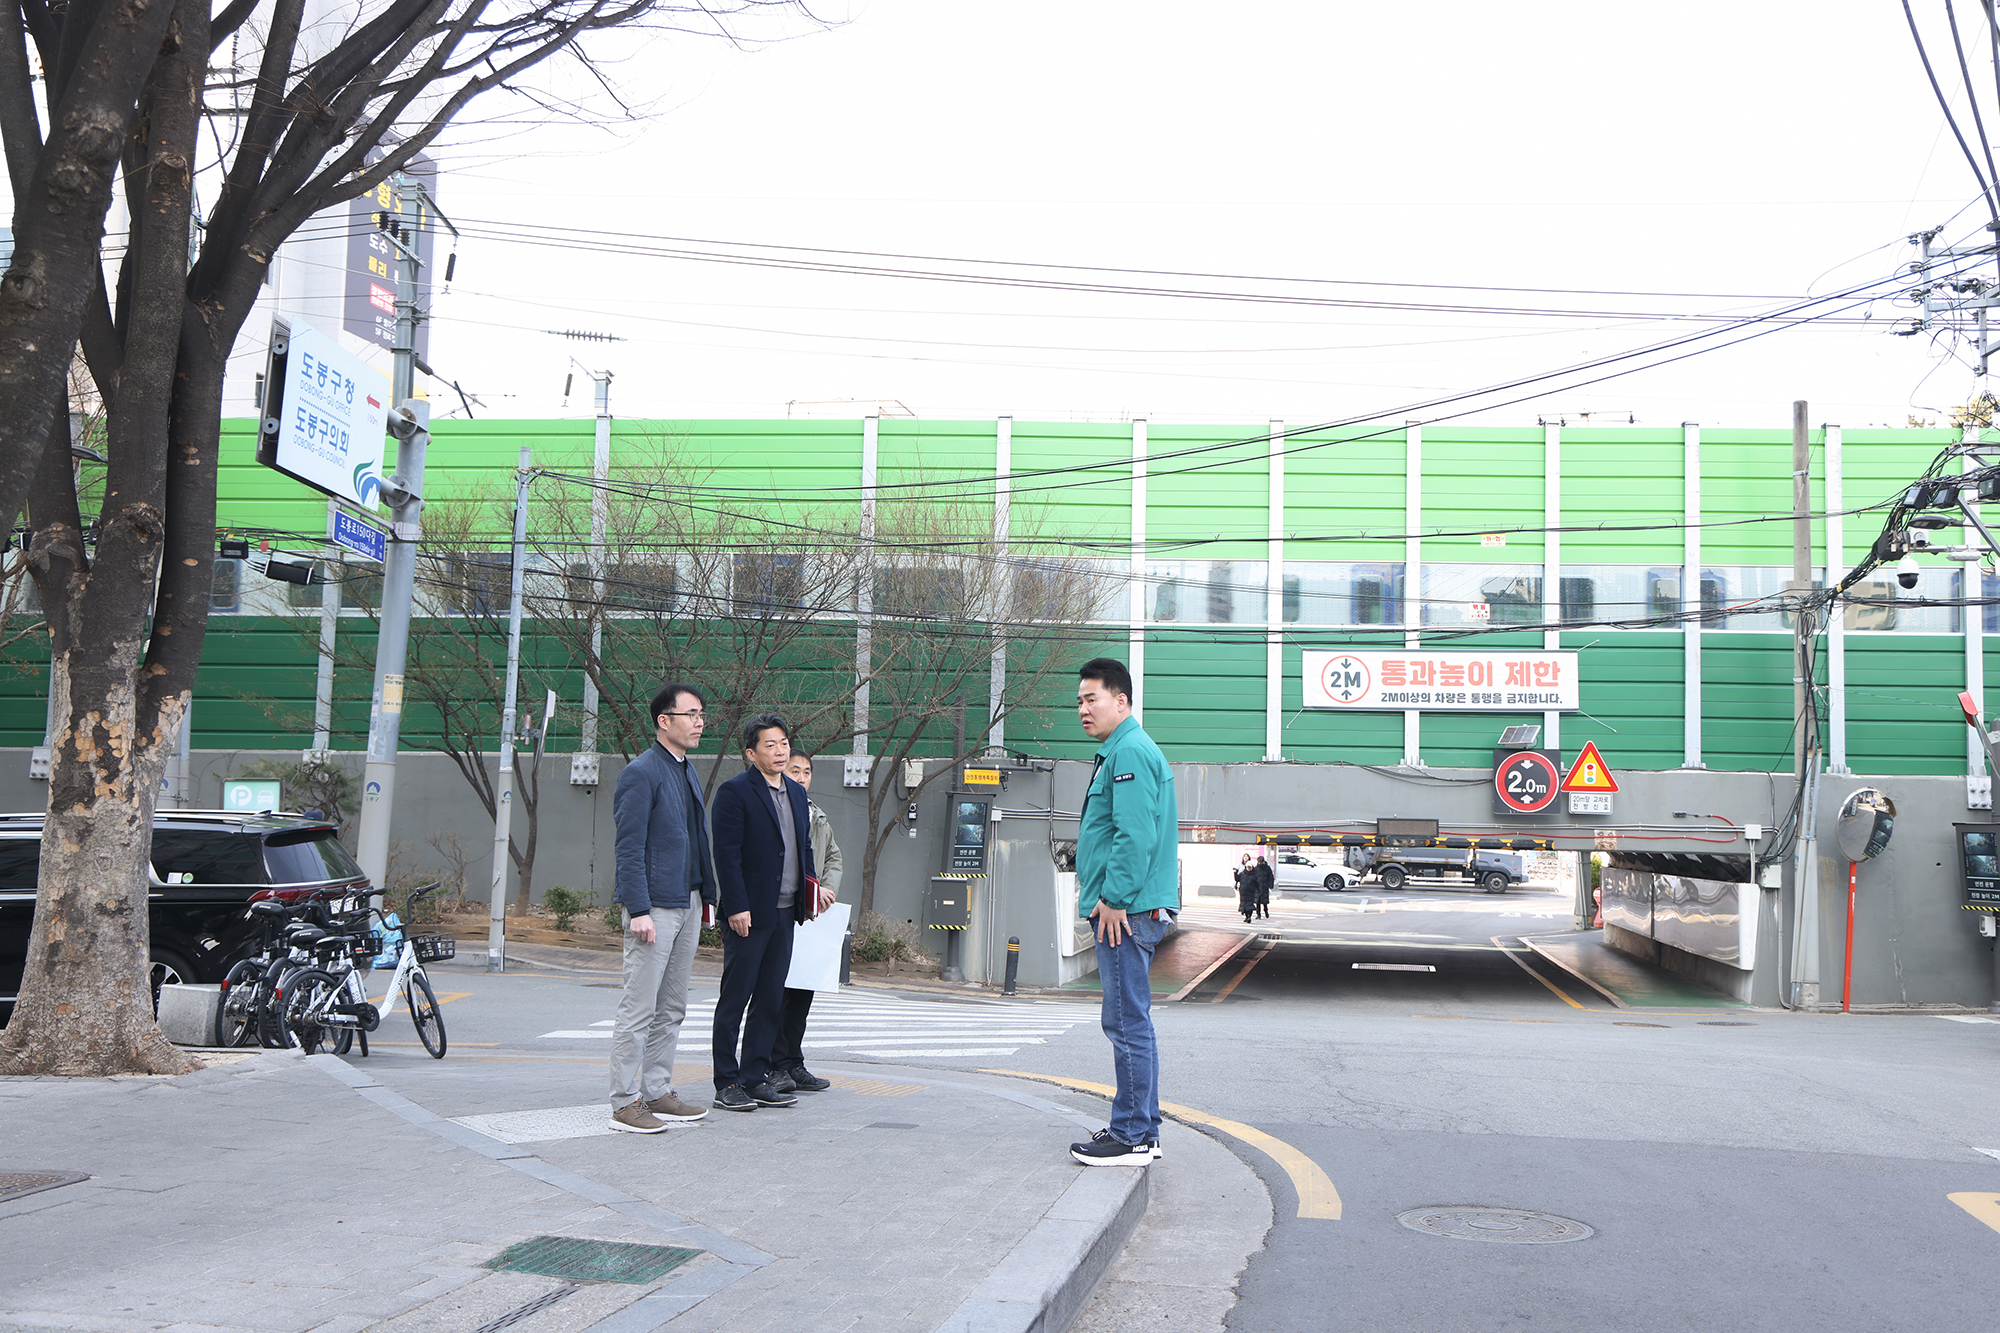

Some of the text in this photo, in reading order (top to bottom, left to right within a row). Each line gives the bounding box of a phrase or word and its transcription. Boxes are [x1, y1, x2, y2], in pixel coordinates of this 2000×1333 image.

[301, 352, 354, 404] 도봉구청
[300, 379, 351, 417] DOBONG-GU OFFICE
[295, 406, 349, 456] 도봉구의회
[293, 434, 345, 469] DOBONG-GU COUNCIL
[1330, 671, 1361, 688] 2M
[1381, 660, 1561, 687] 통과높이 제한
[1381, 692, 1563, 704] 2M이상의 차량은 통행을 금지합니다.
[1508, 770, 1547, 794] 2.0m
